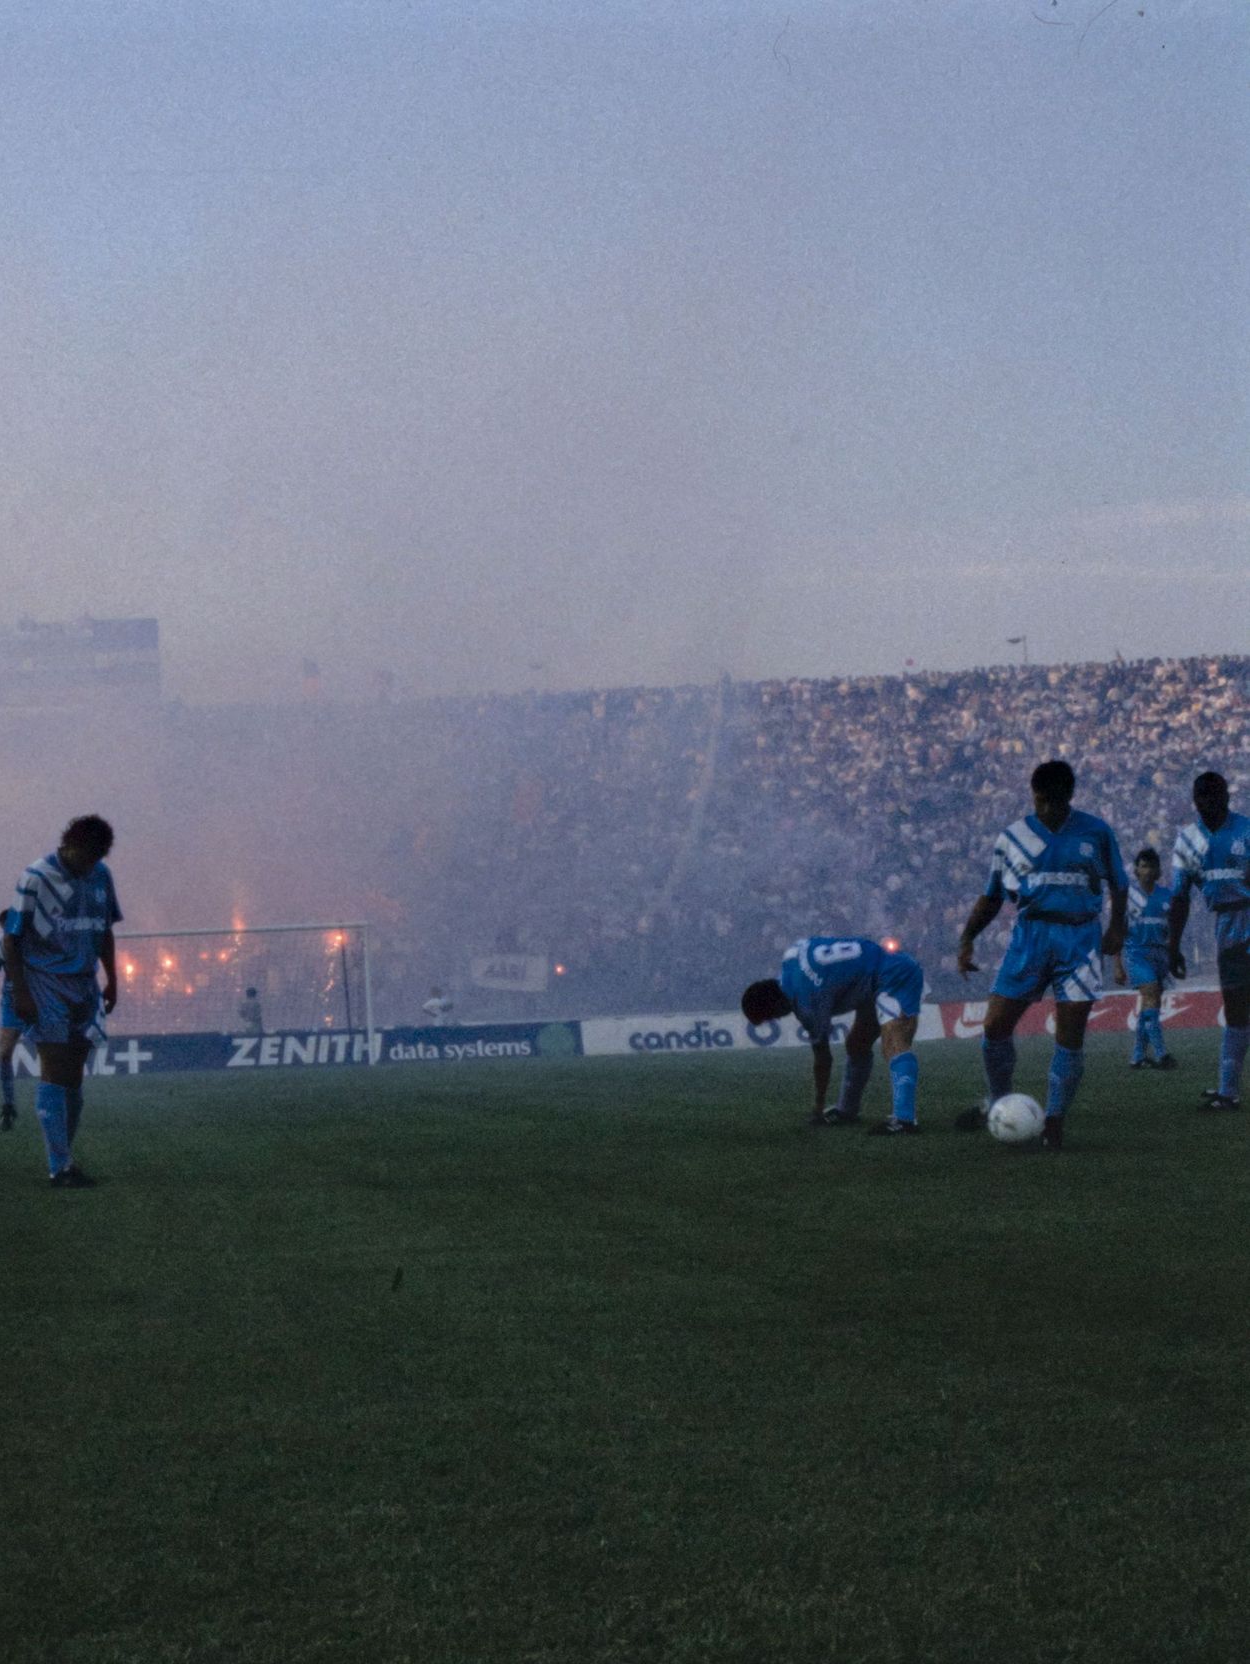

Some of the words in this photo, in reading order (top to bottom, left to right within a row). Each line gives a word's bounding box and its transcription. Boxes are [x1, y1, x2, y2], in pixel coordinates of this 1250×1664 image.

[226, 1033, 382, 1067] ZENITH
[390, 1043, 439, 1061] data
[444, 1038, 531, 1062] systems
[629, 1020, 734, 1050] candia
